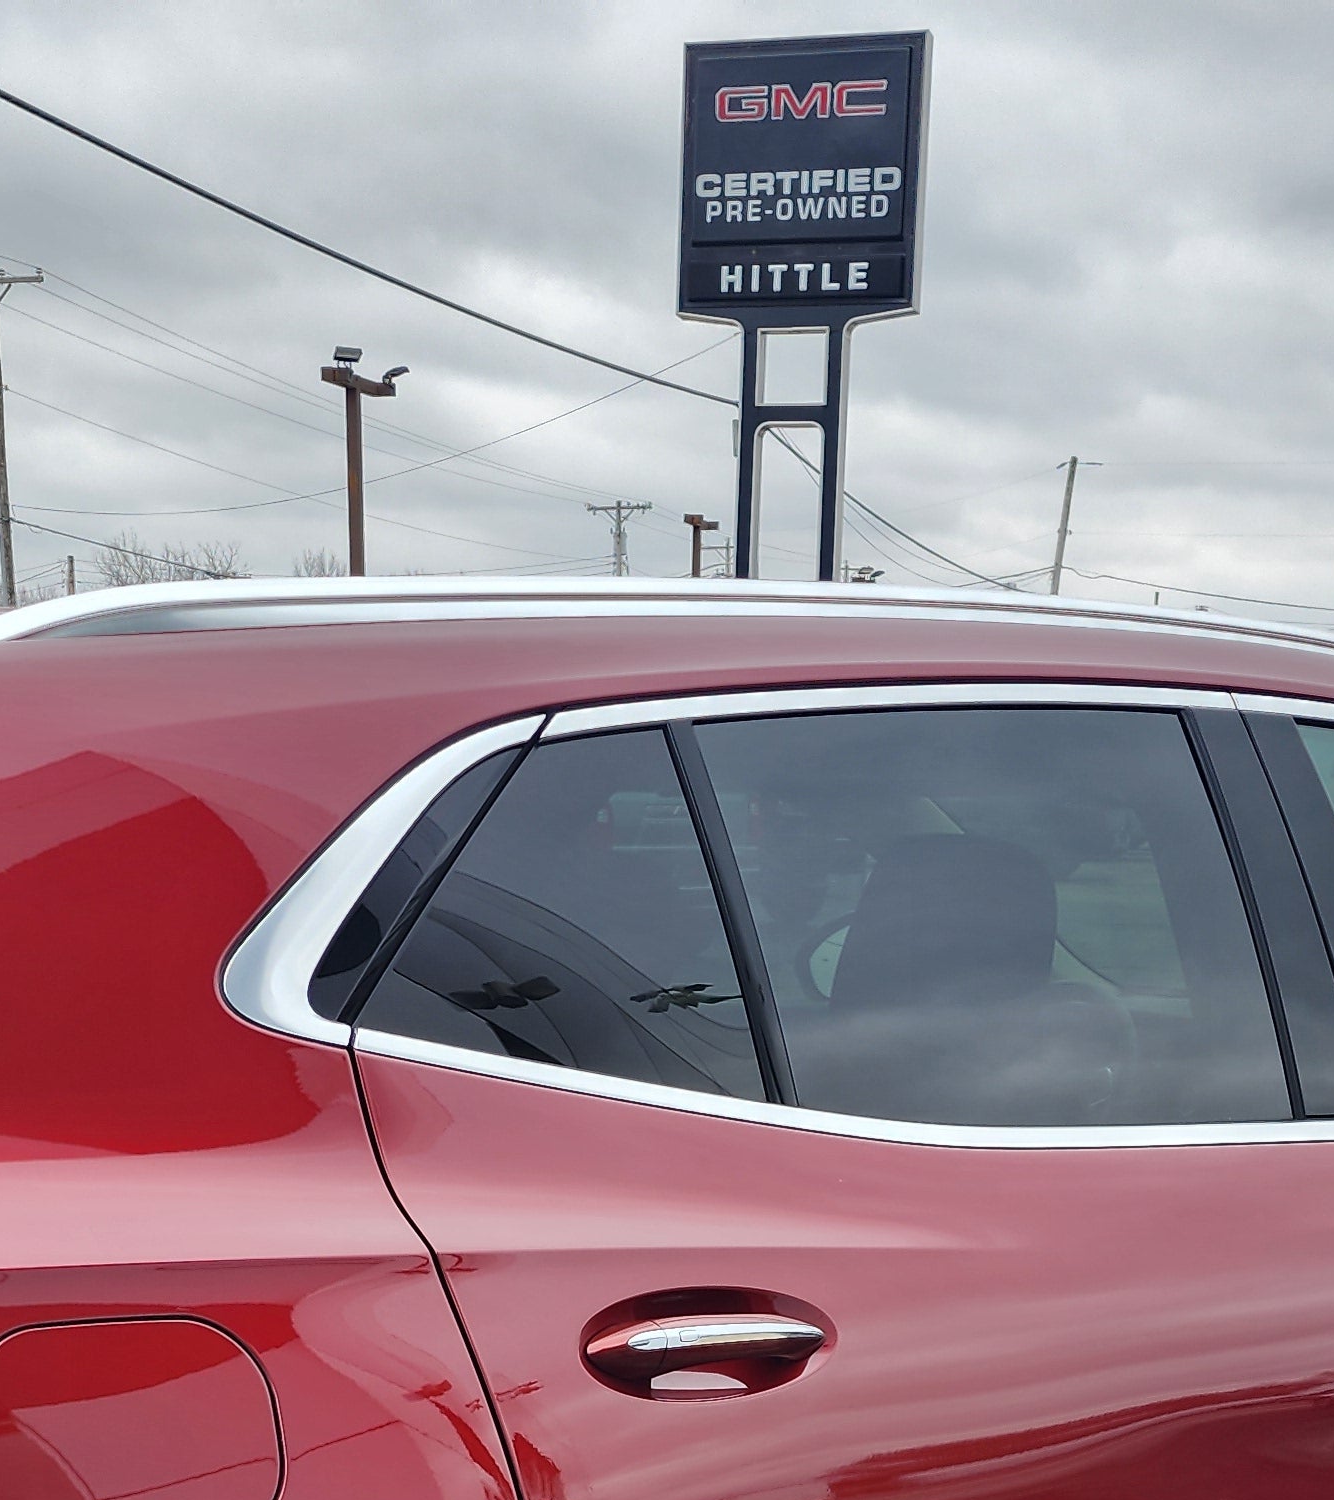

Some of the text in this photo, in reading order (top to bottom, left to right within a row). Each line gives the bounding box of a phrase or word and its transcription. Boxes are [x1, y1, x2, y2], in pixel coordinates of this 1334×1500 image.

[715, 78, 888, 122] GMC
[695, 166, 902, 198] CERTIFIED
[705, 194, 890, 223] PRE-OWNED
[720, 262, 869, 293] HITTLE
